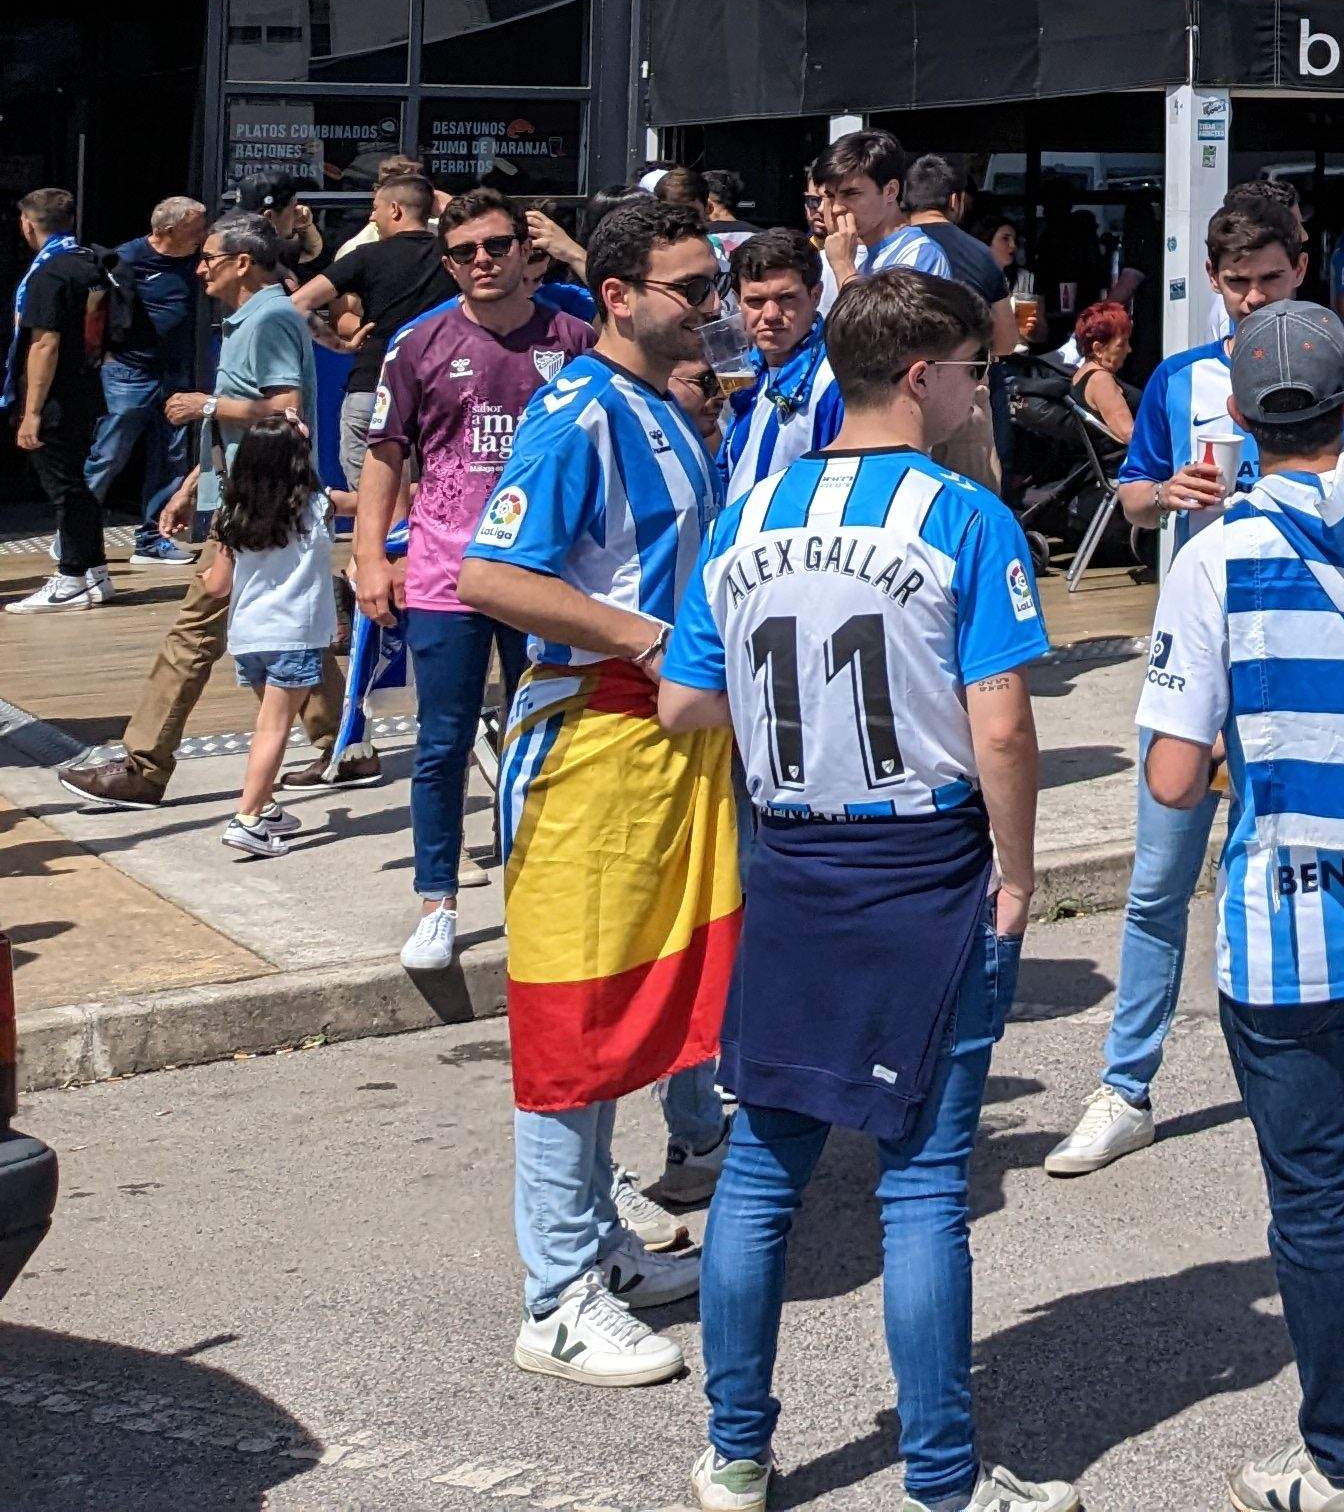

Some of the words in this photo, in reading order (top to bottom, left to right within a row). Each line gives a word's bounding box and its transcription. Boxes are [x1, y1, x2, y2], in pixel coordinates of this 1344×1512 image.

[235, 123, 287, 139] PLATOS
[290, 124, 378, 139] COMBINADOS
[432, 121, 507, 136] DESAYUNOS
[235, 144, 302, 159] RACIONES
[432, 139, 469, 155] ZUMO
[472, 139, 489, 155] DE
[491, 140, 549, 156] NARANJA
[431, 159, 494, 174] PERRITOS
[472, 402, 502, 413] sabor
[480, 526, 512, 541] LaLiga
[726, 538, 794, 609] ALEX
[803, 535, 926, 609] GALLAR
[1145, 669, 1186, 693] CCER
[745, 613, 906, 791] 11
